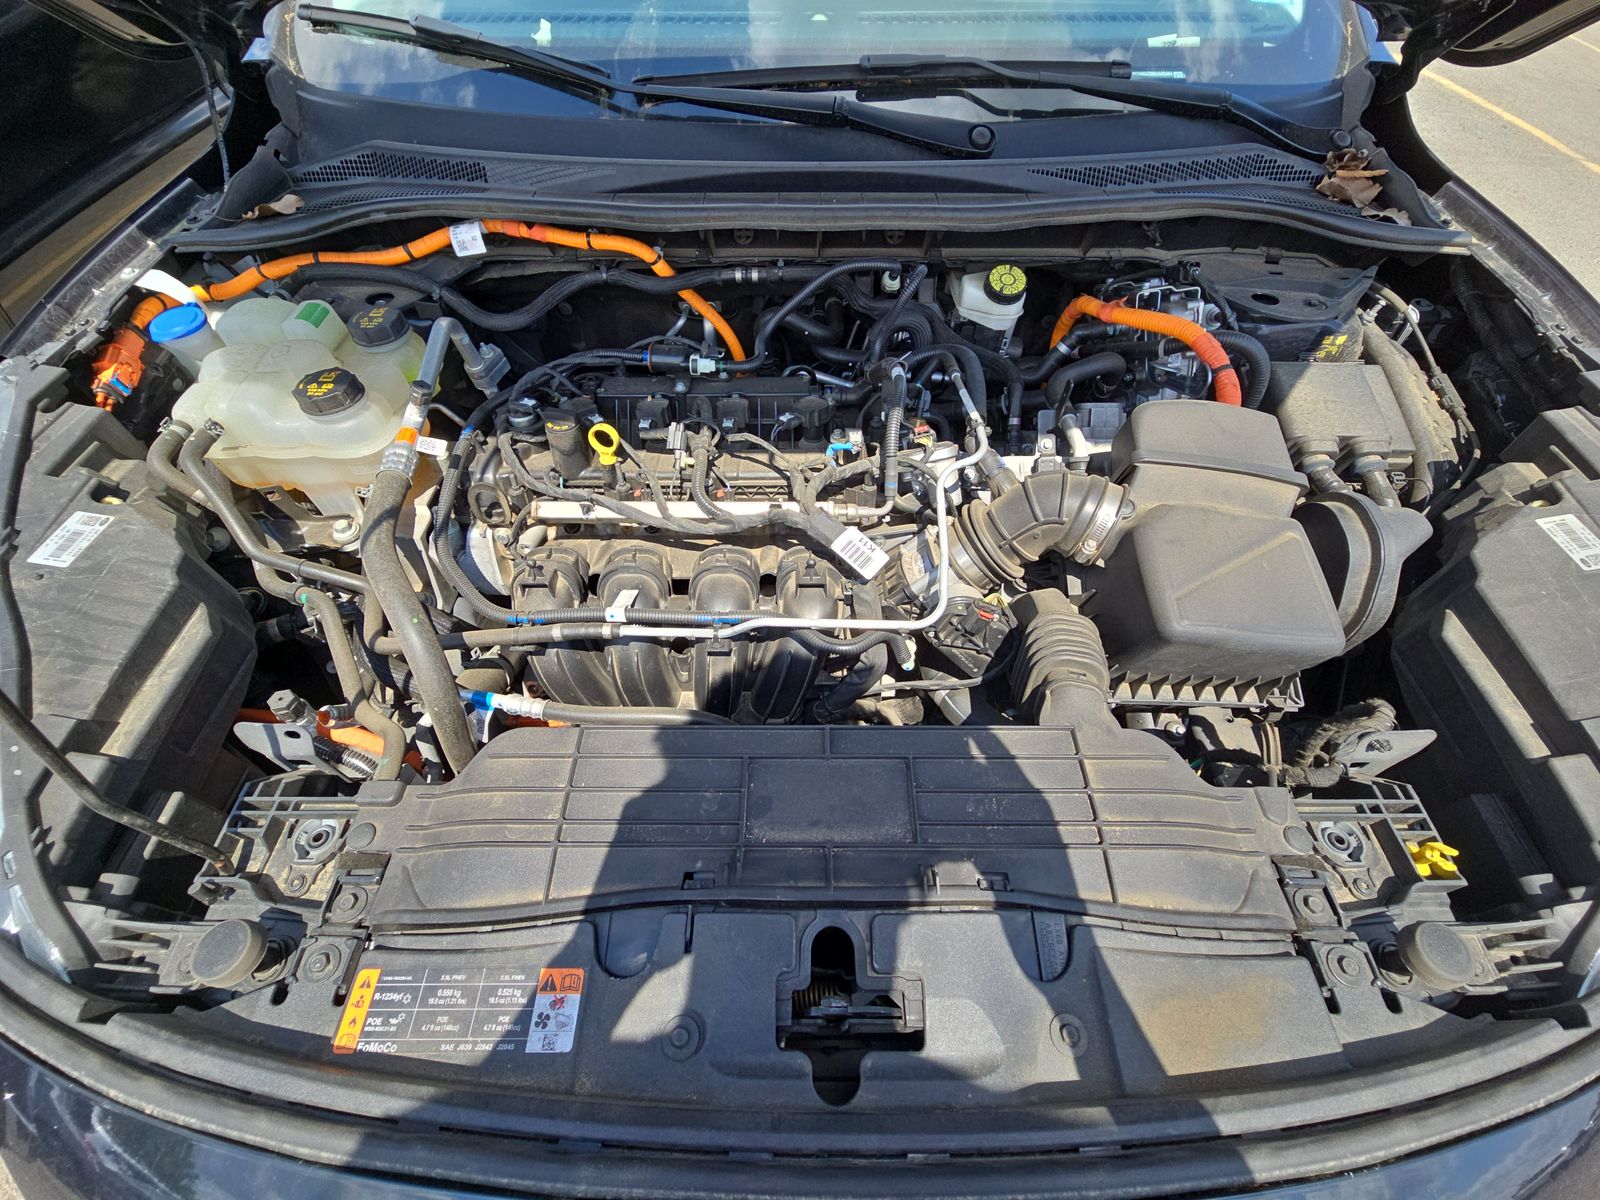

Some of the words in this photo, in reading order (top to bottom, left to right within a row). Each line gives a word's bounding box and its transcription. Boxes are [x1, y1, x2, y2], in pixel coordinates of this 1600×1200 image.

[374, 992, 404, 1002] R-1234yf
[453, 989, 462, 998] kg
[513, 989, 522, 998] kg
[366, 1017, 383, 1025] POE
[356, 1042, 398, 1052] FoMoCo
